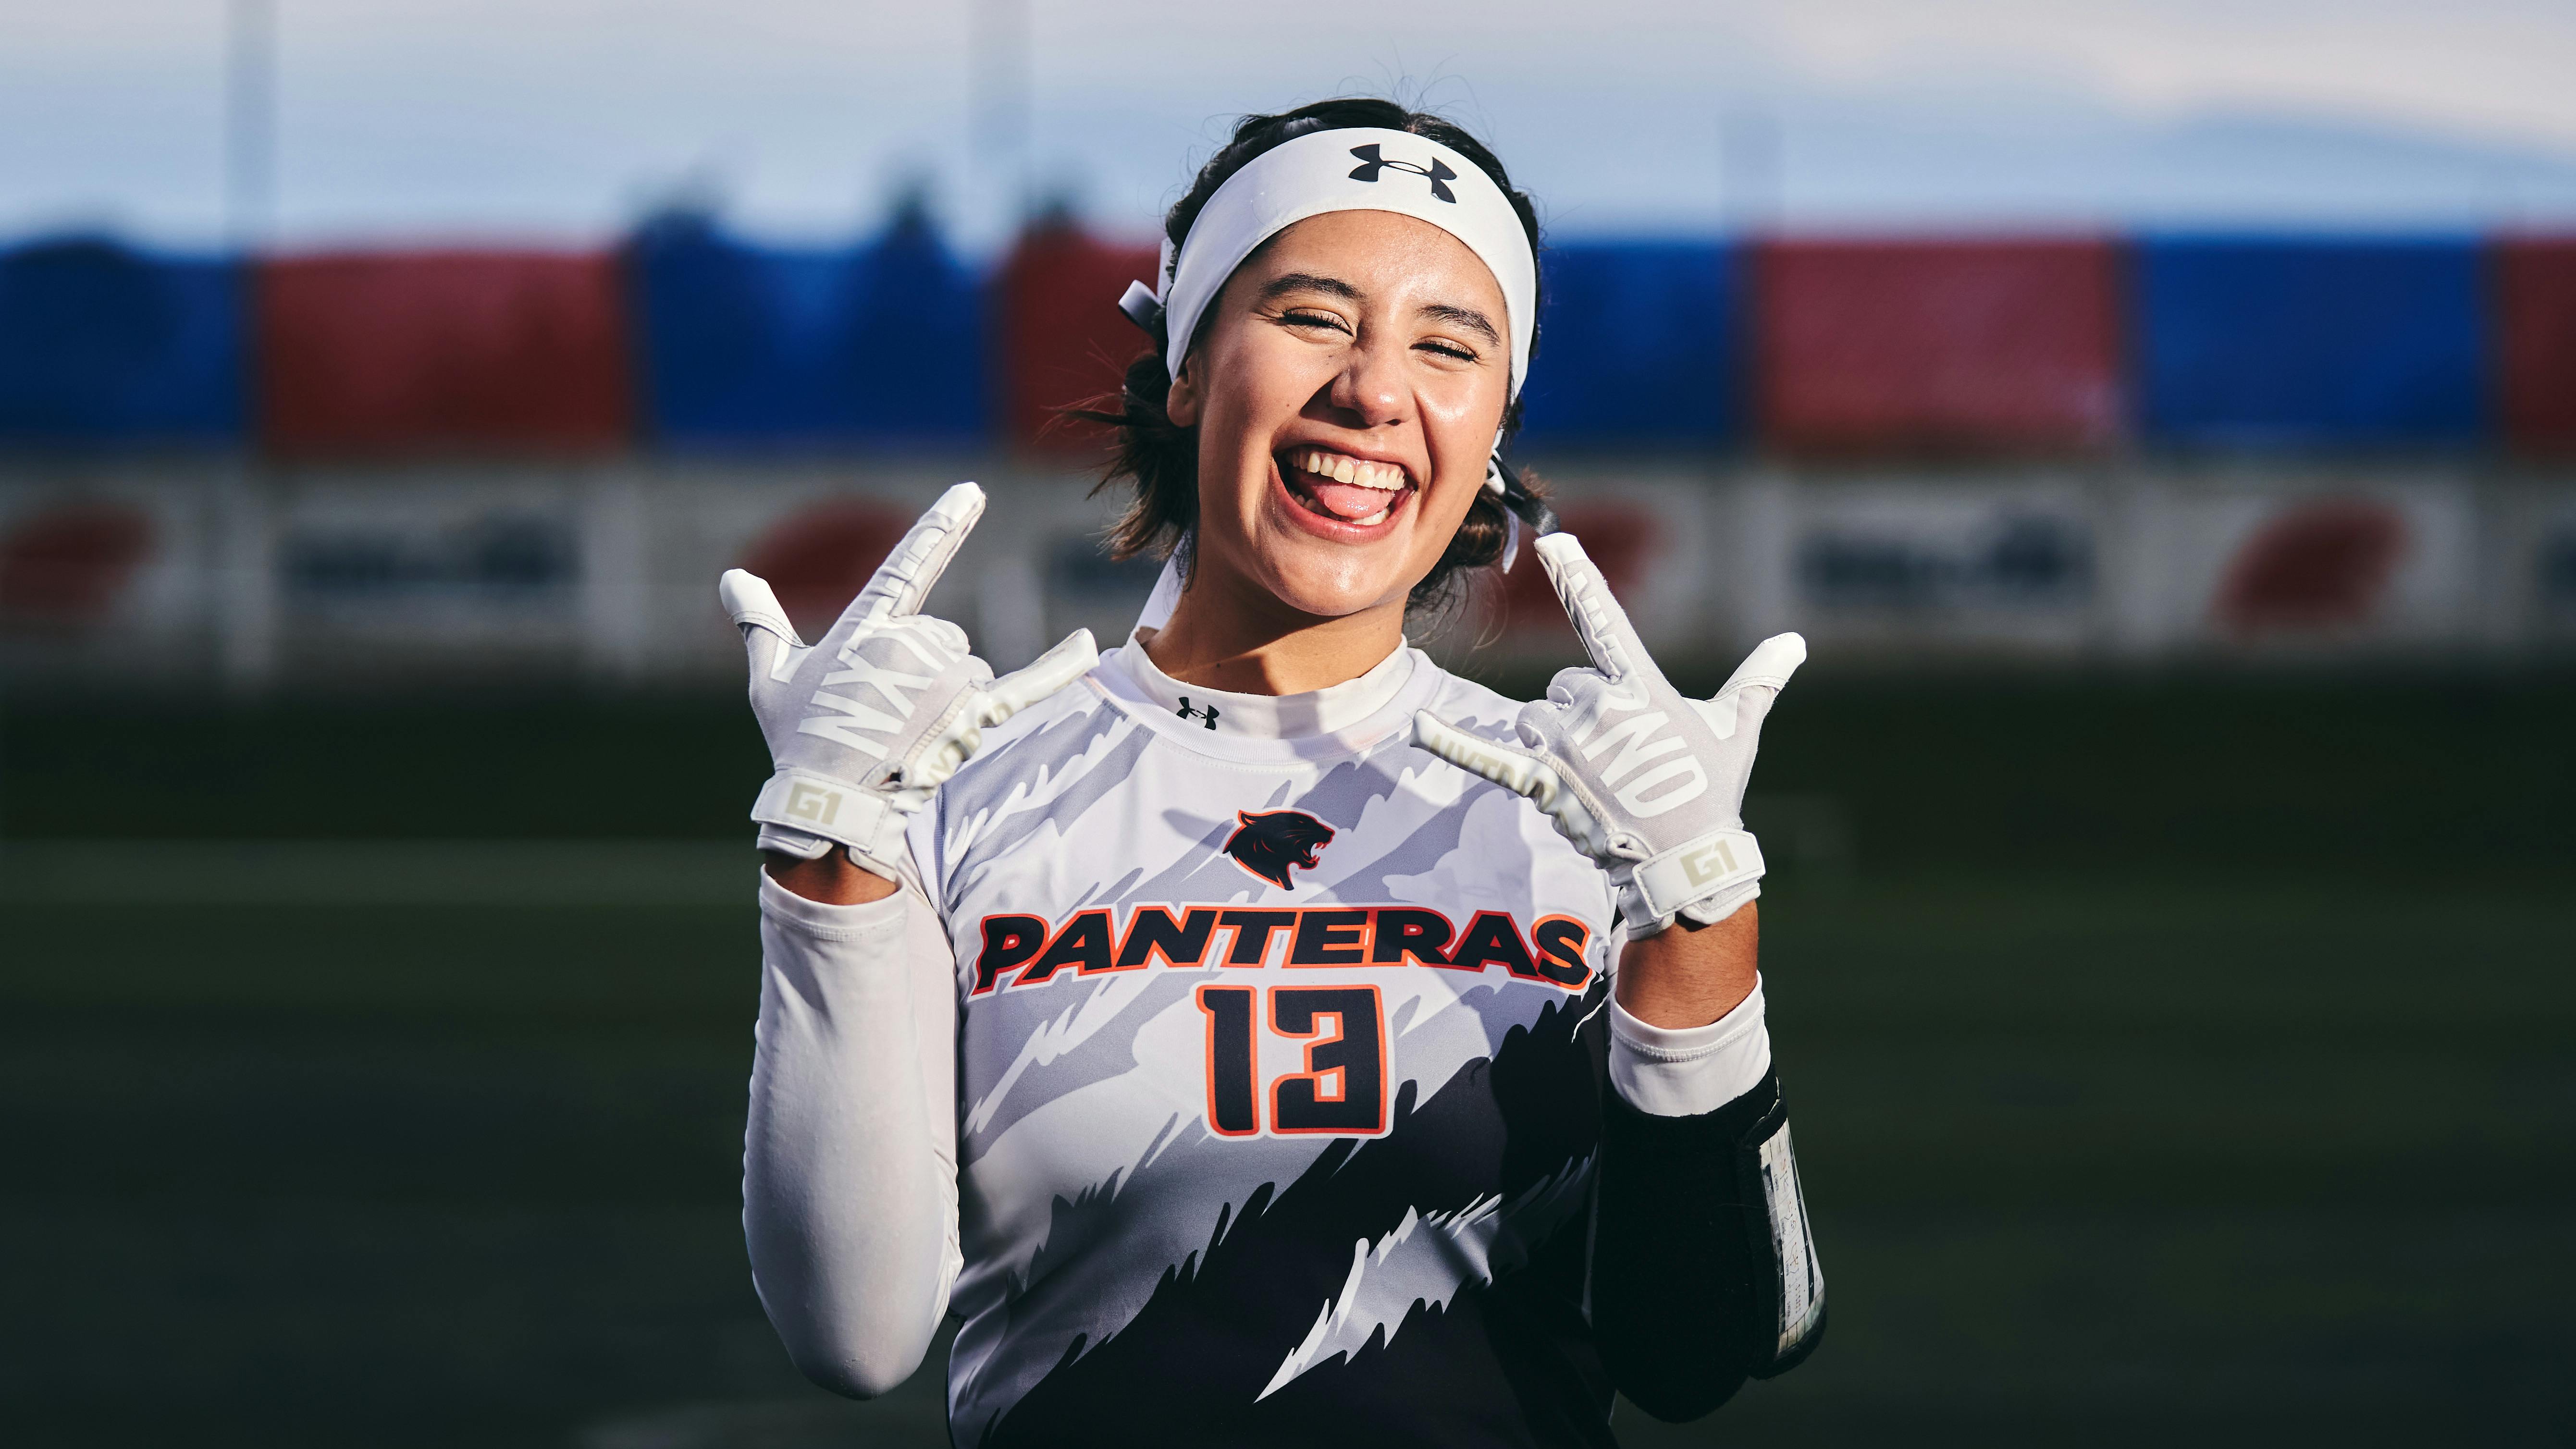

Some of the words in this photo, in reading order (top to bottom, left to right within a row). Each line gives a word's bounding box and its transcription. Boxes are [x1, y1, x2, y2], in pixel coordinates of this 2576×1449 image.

[785, 782, 842, 825] G1
[1679, 838, 1738, 888] G1
[971, 906, 1592, 995] PANTERAS
[1195, 984, 1389, 1136] 13
